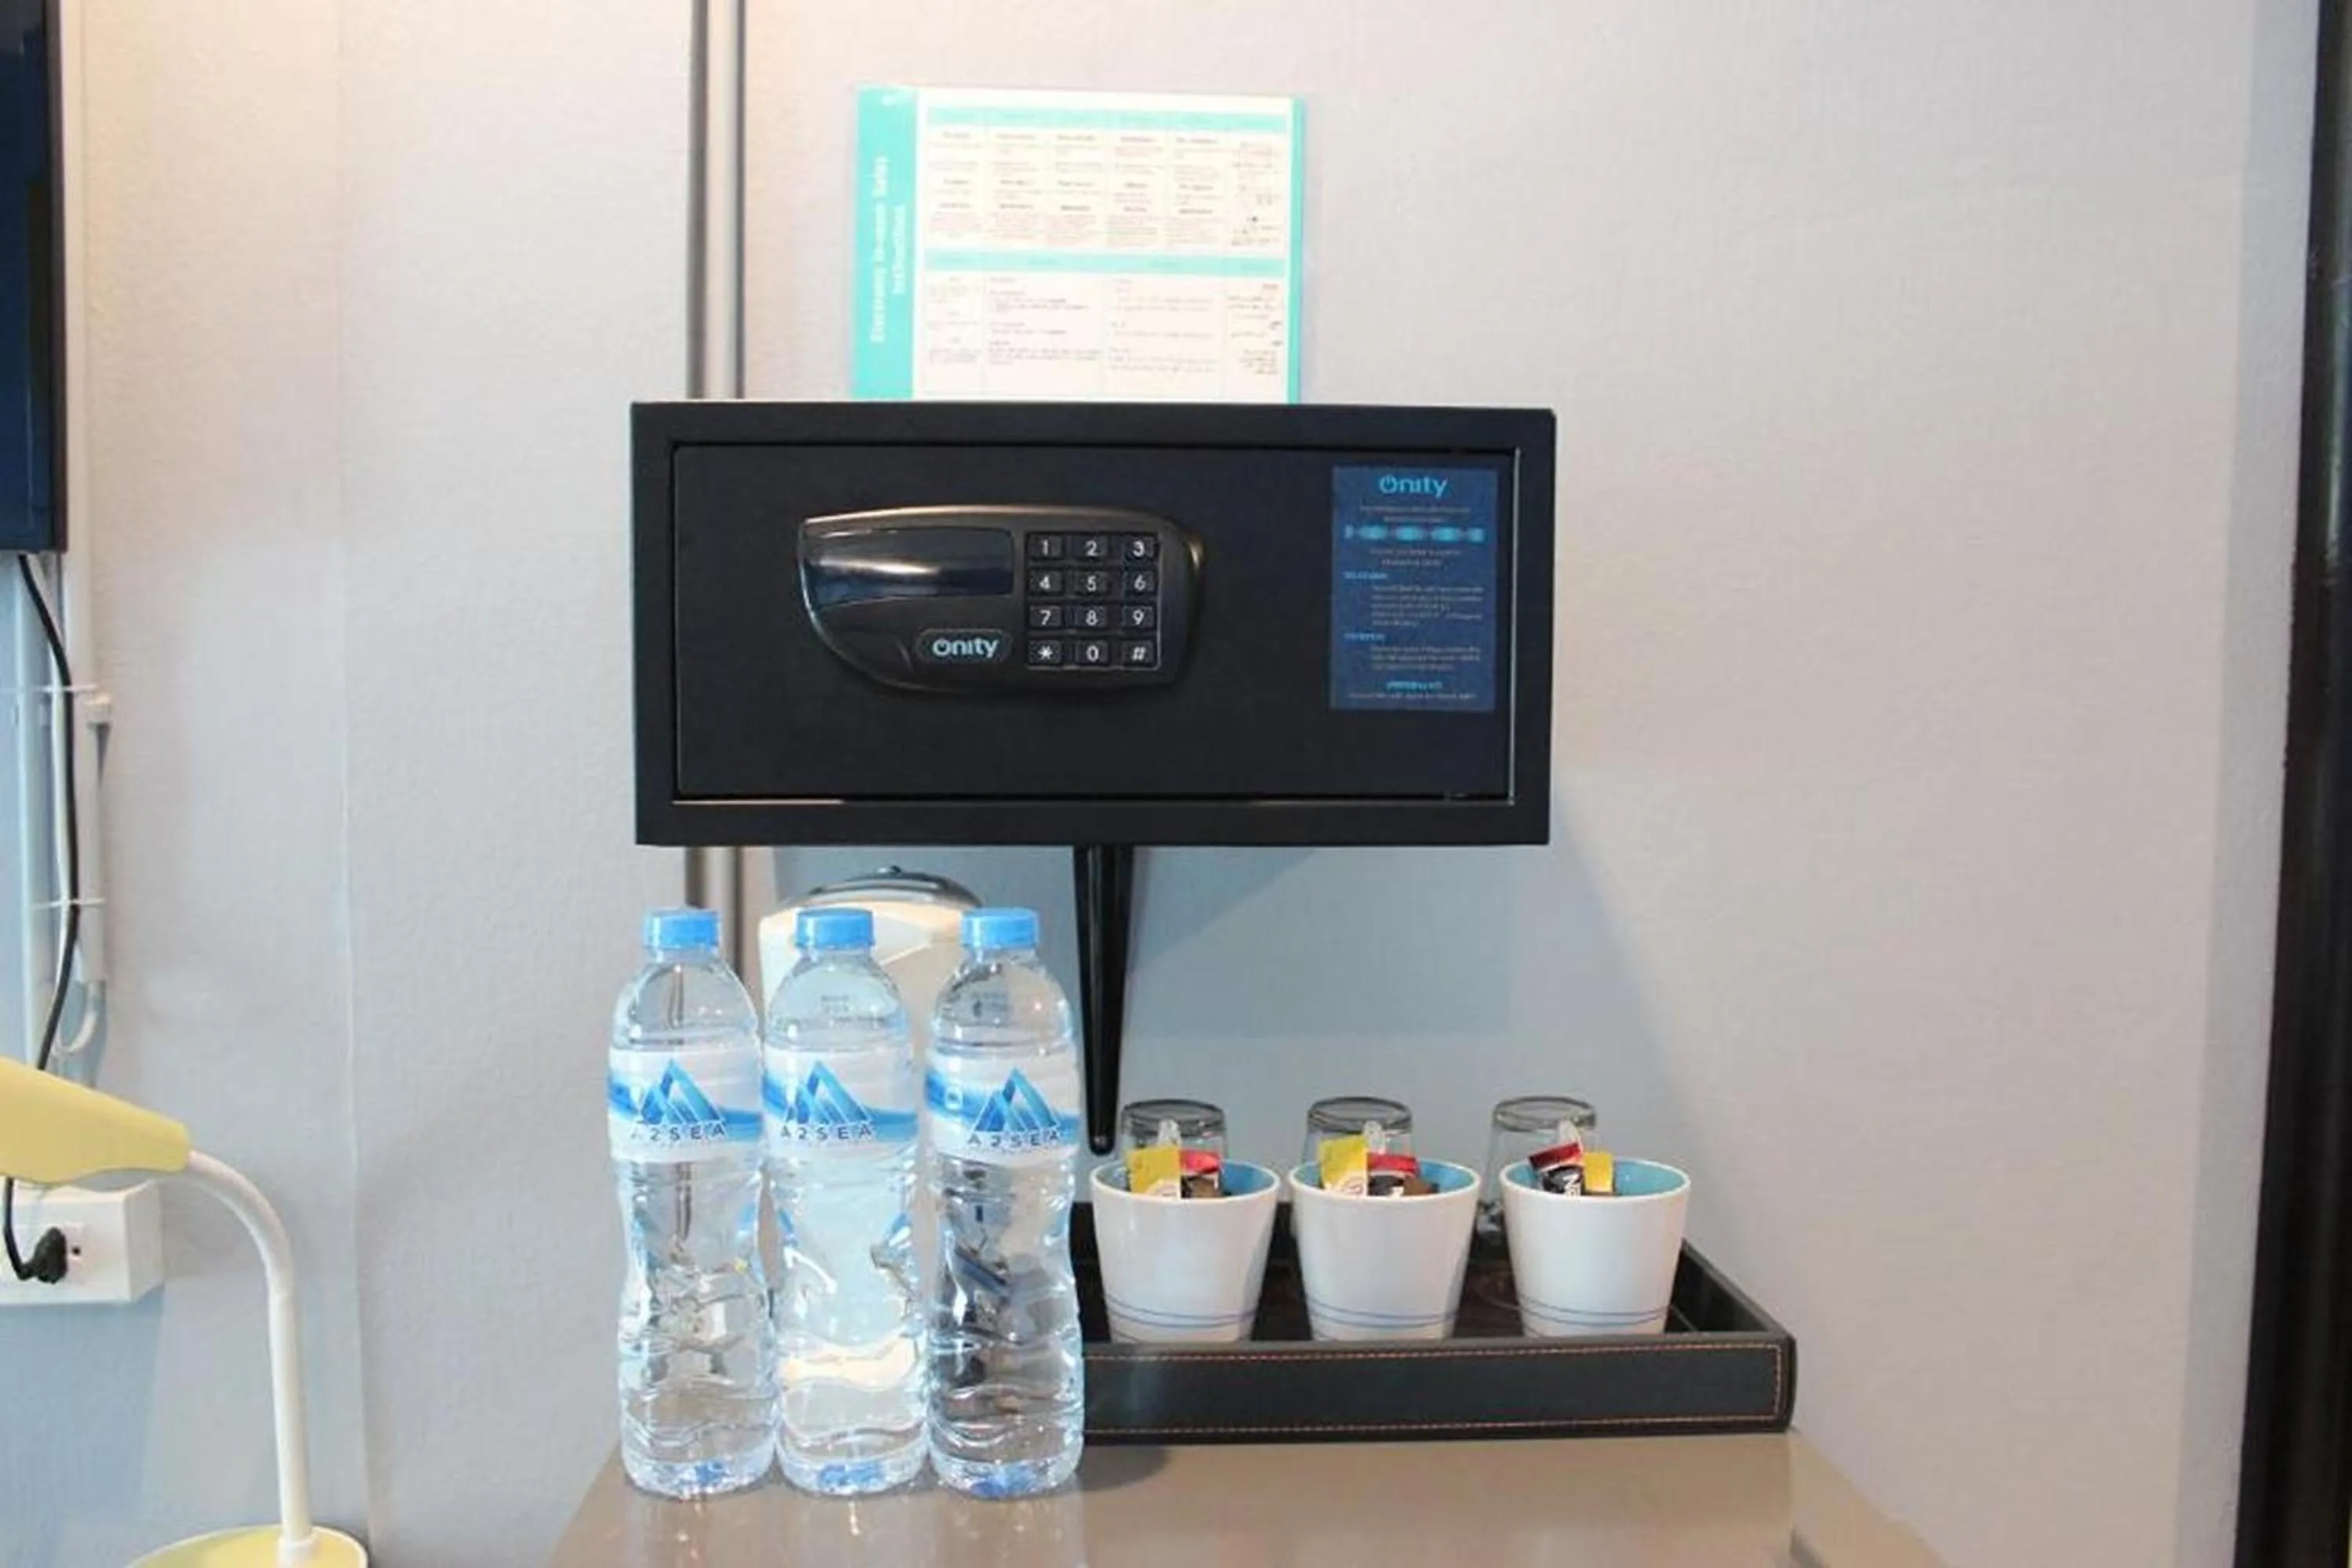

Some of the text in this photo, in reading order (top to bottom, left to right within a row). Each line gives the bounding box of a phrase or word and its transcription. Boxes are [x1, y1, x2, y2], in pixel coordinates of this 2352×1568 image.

[1380, 474, 1448, 499] Onity
[1043, 539, 1145, 557] 1 2 3
[1039, 575, 1145, 592] 4 5 6
[1041, 609, 1144, 626] 7 8 9
[933, 638, 998, 659] Onity
[1087, 645, 1098, 662] 0
[630, 1121, 726, 1141] A2SEA
[780, 1122, 872, 1141] A2SEA
[967, 1129, 1059, 1148] A2SEA
